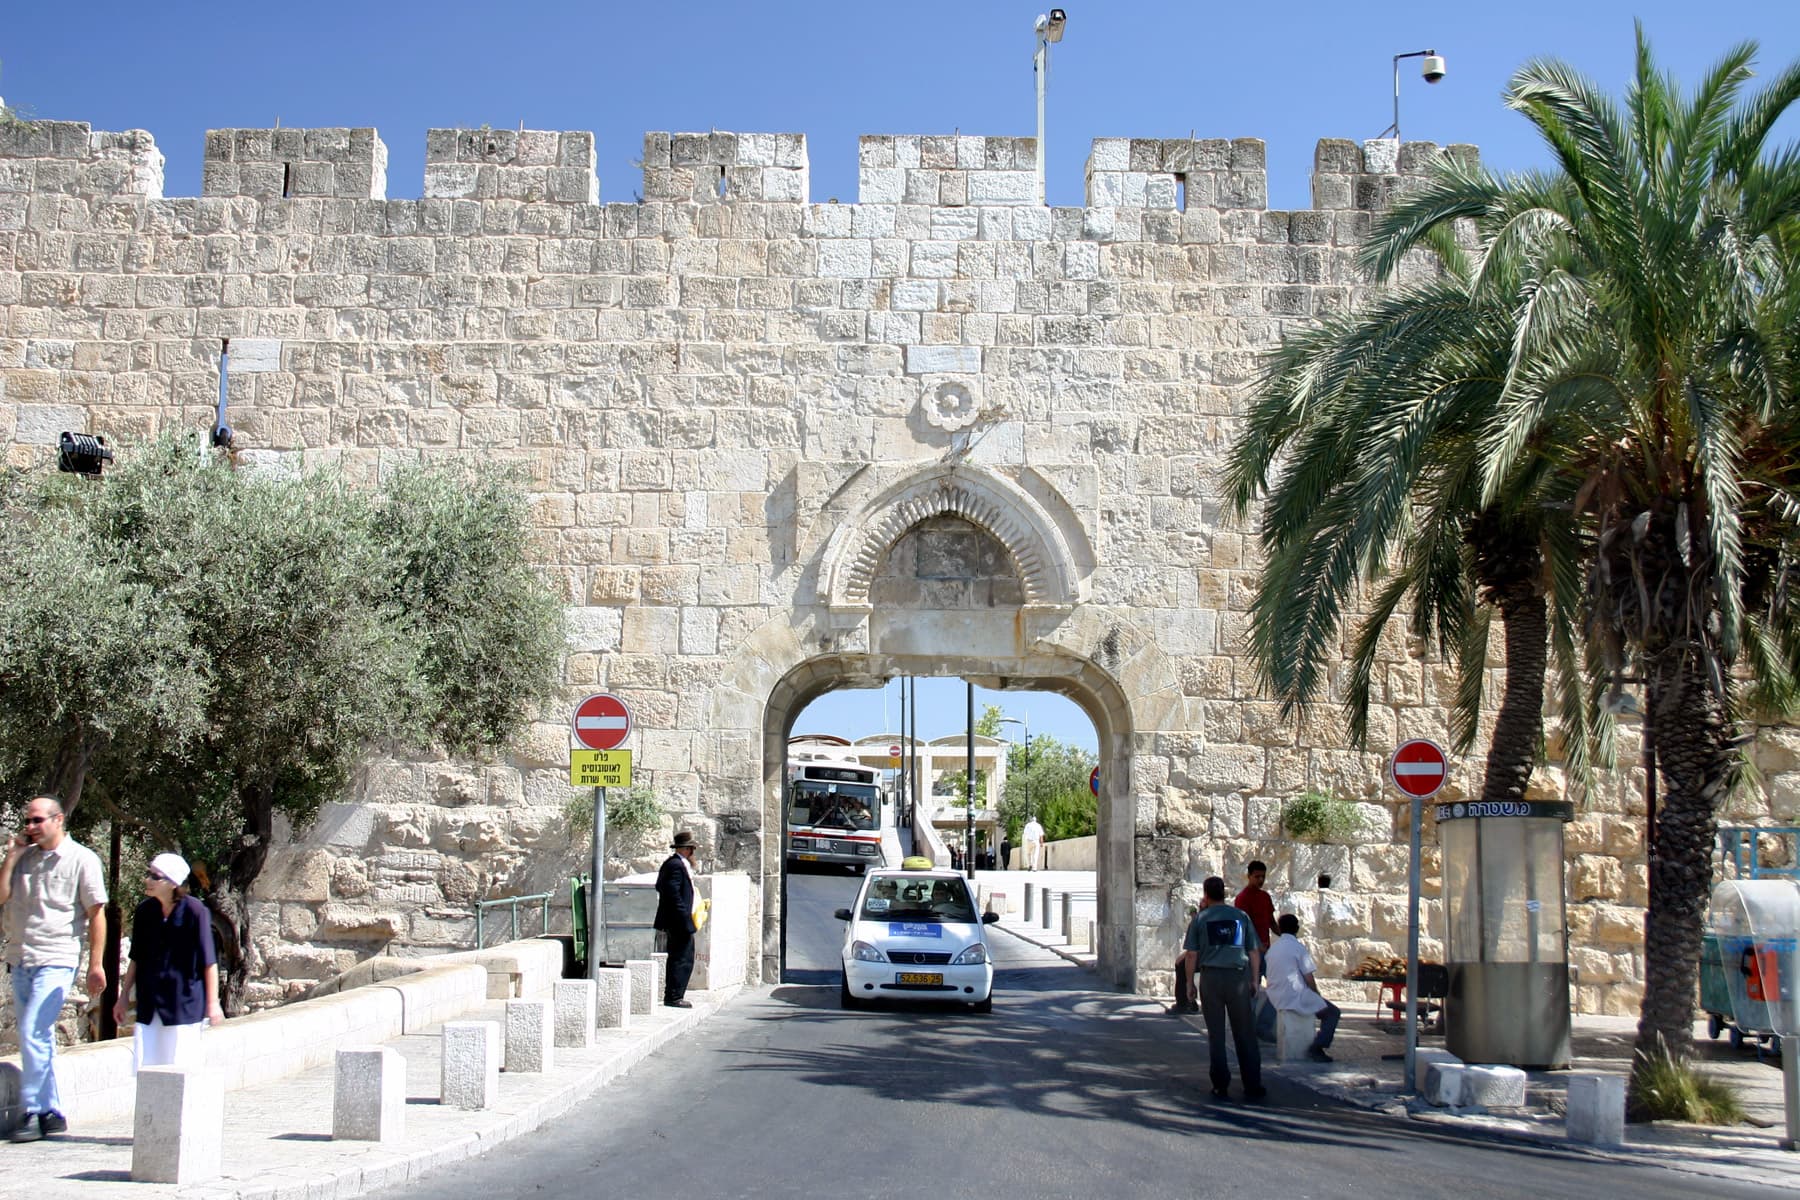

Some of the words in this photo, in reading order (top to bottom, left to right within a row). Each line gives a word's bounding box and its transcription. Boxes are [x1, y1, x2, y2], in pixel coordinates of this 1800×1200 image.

[593, 753, 609, 761] פרט
[581, 763, 621, 772] לאוטובוסים
[580, 775, 599, 784] שרות
[603, 775, 621, 784] בקווי
[1468, 802, 1530, 816] משטרה
